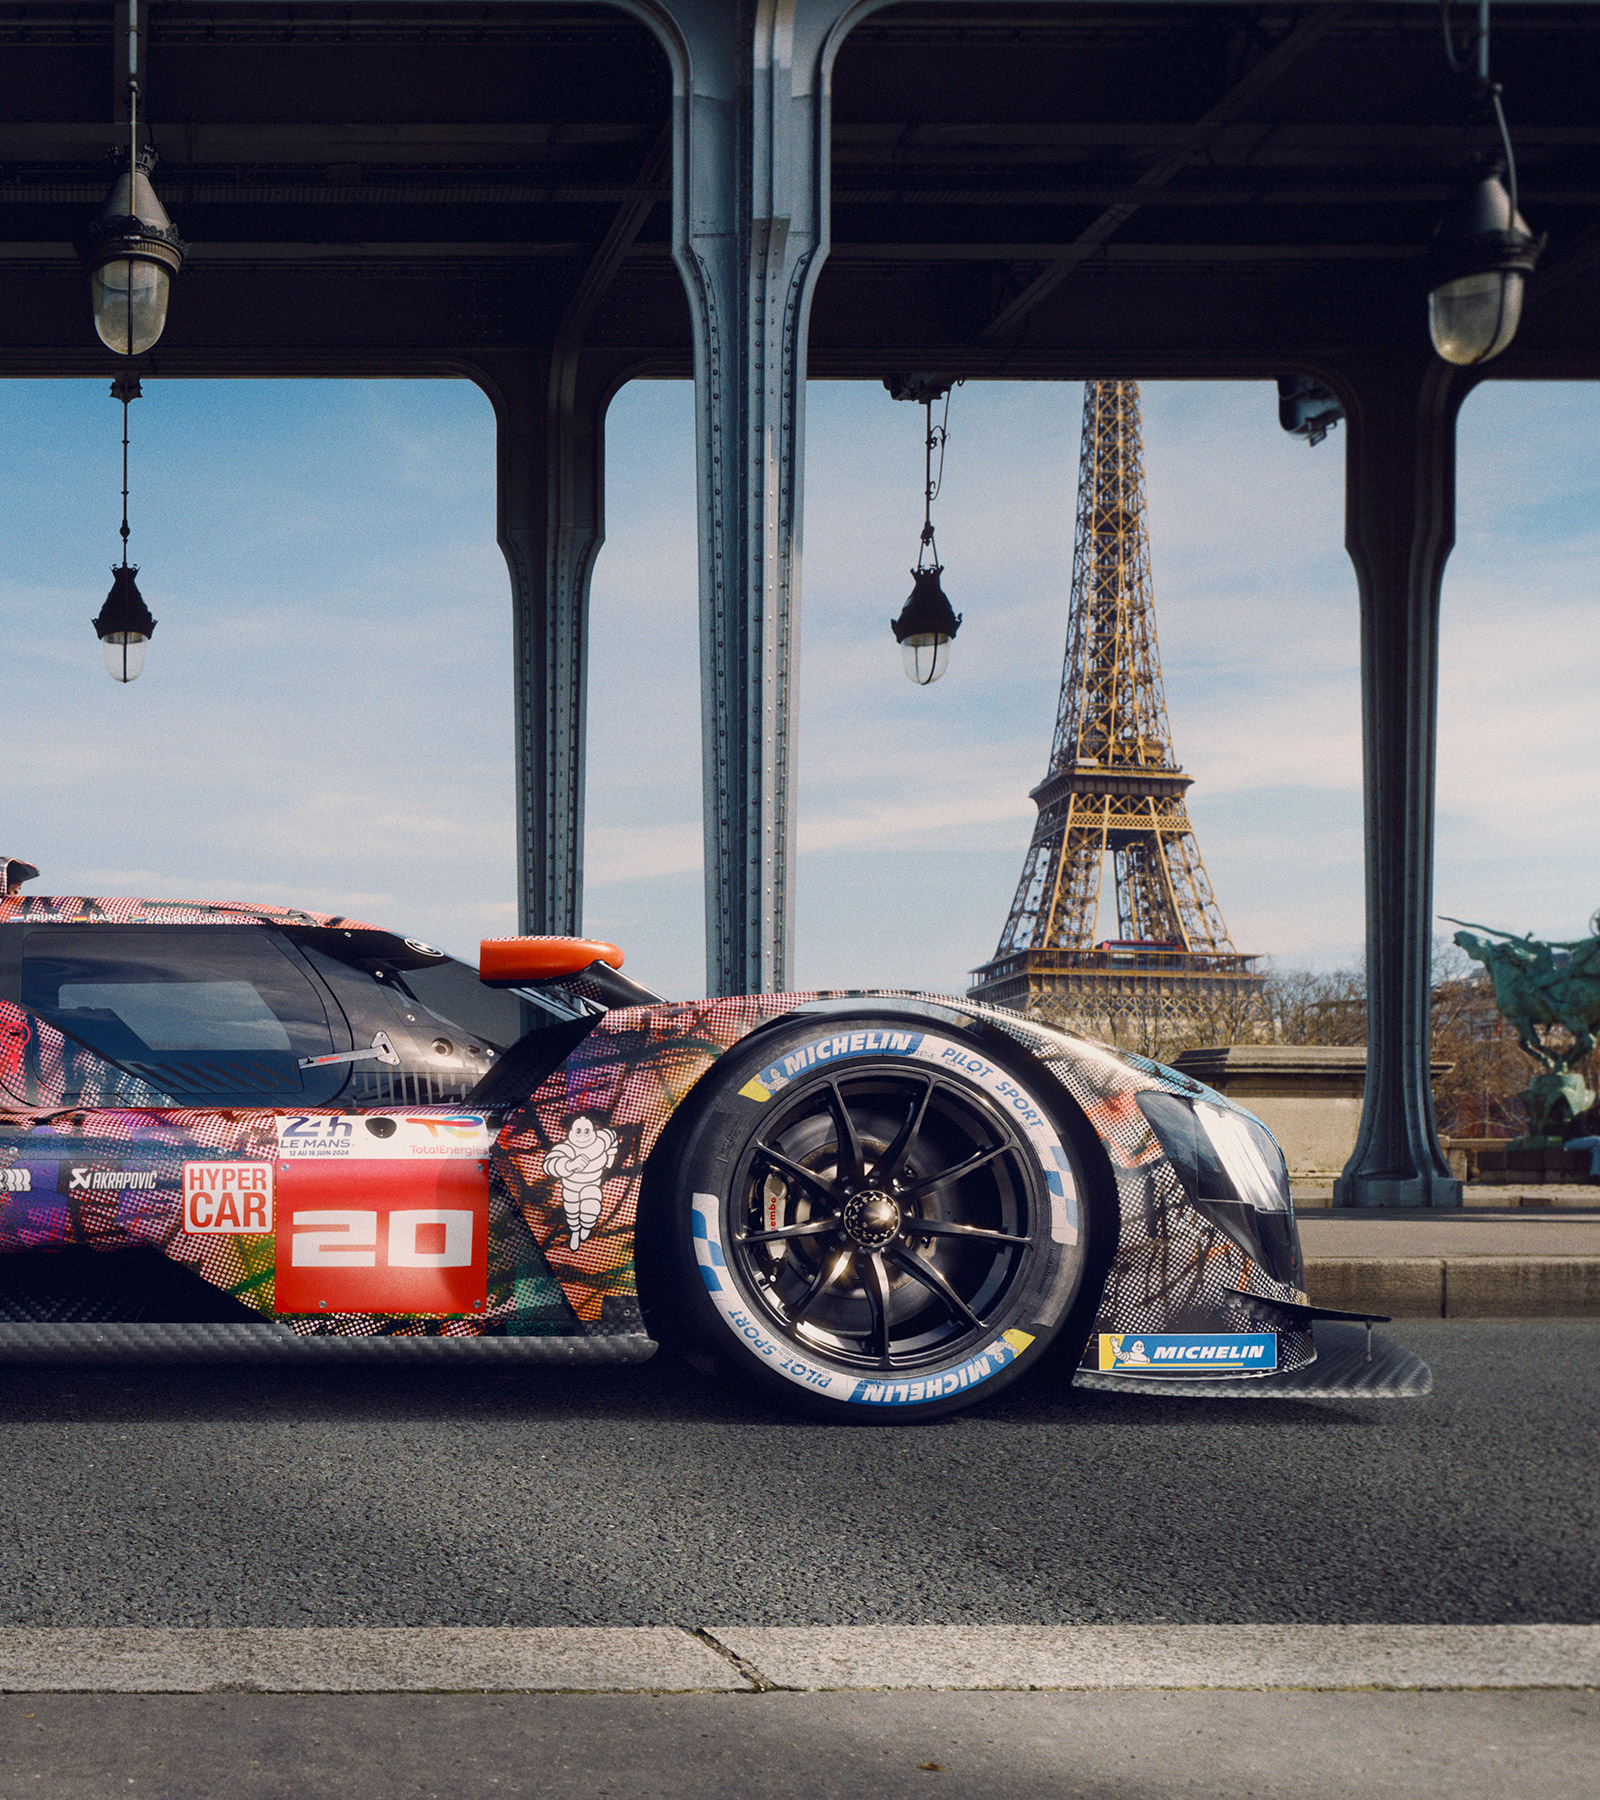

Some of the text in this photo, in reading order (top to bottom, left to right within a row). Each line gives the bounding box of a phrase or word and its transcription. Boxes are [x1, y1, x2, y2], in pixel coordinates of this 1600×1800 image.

[783, 1032, 912, 1077] MICHELIN
[940, 1047, 1044, 1128] PILOT SPORT
[280, 1139, 351, 1149] LE MANS
[282, 1116, 353, 1138] 24h
[409, 1144, 489, 1157] TotalEnergies
[189, 1168, 267, 1191] HYPER
[189, 1191, 267, 1228] CAR
[291, 1209, 474, 1268] 20
[727, 1310, 833, 1389] PILOT SPORT
[1153, 1344, 1265, 1360] MICHELIN
[861, 1356, 992, 1402] MICHELIN
